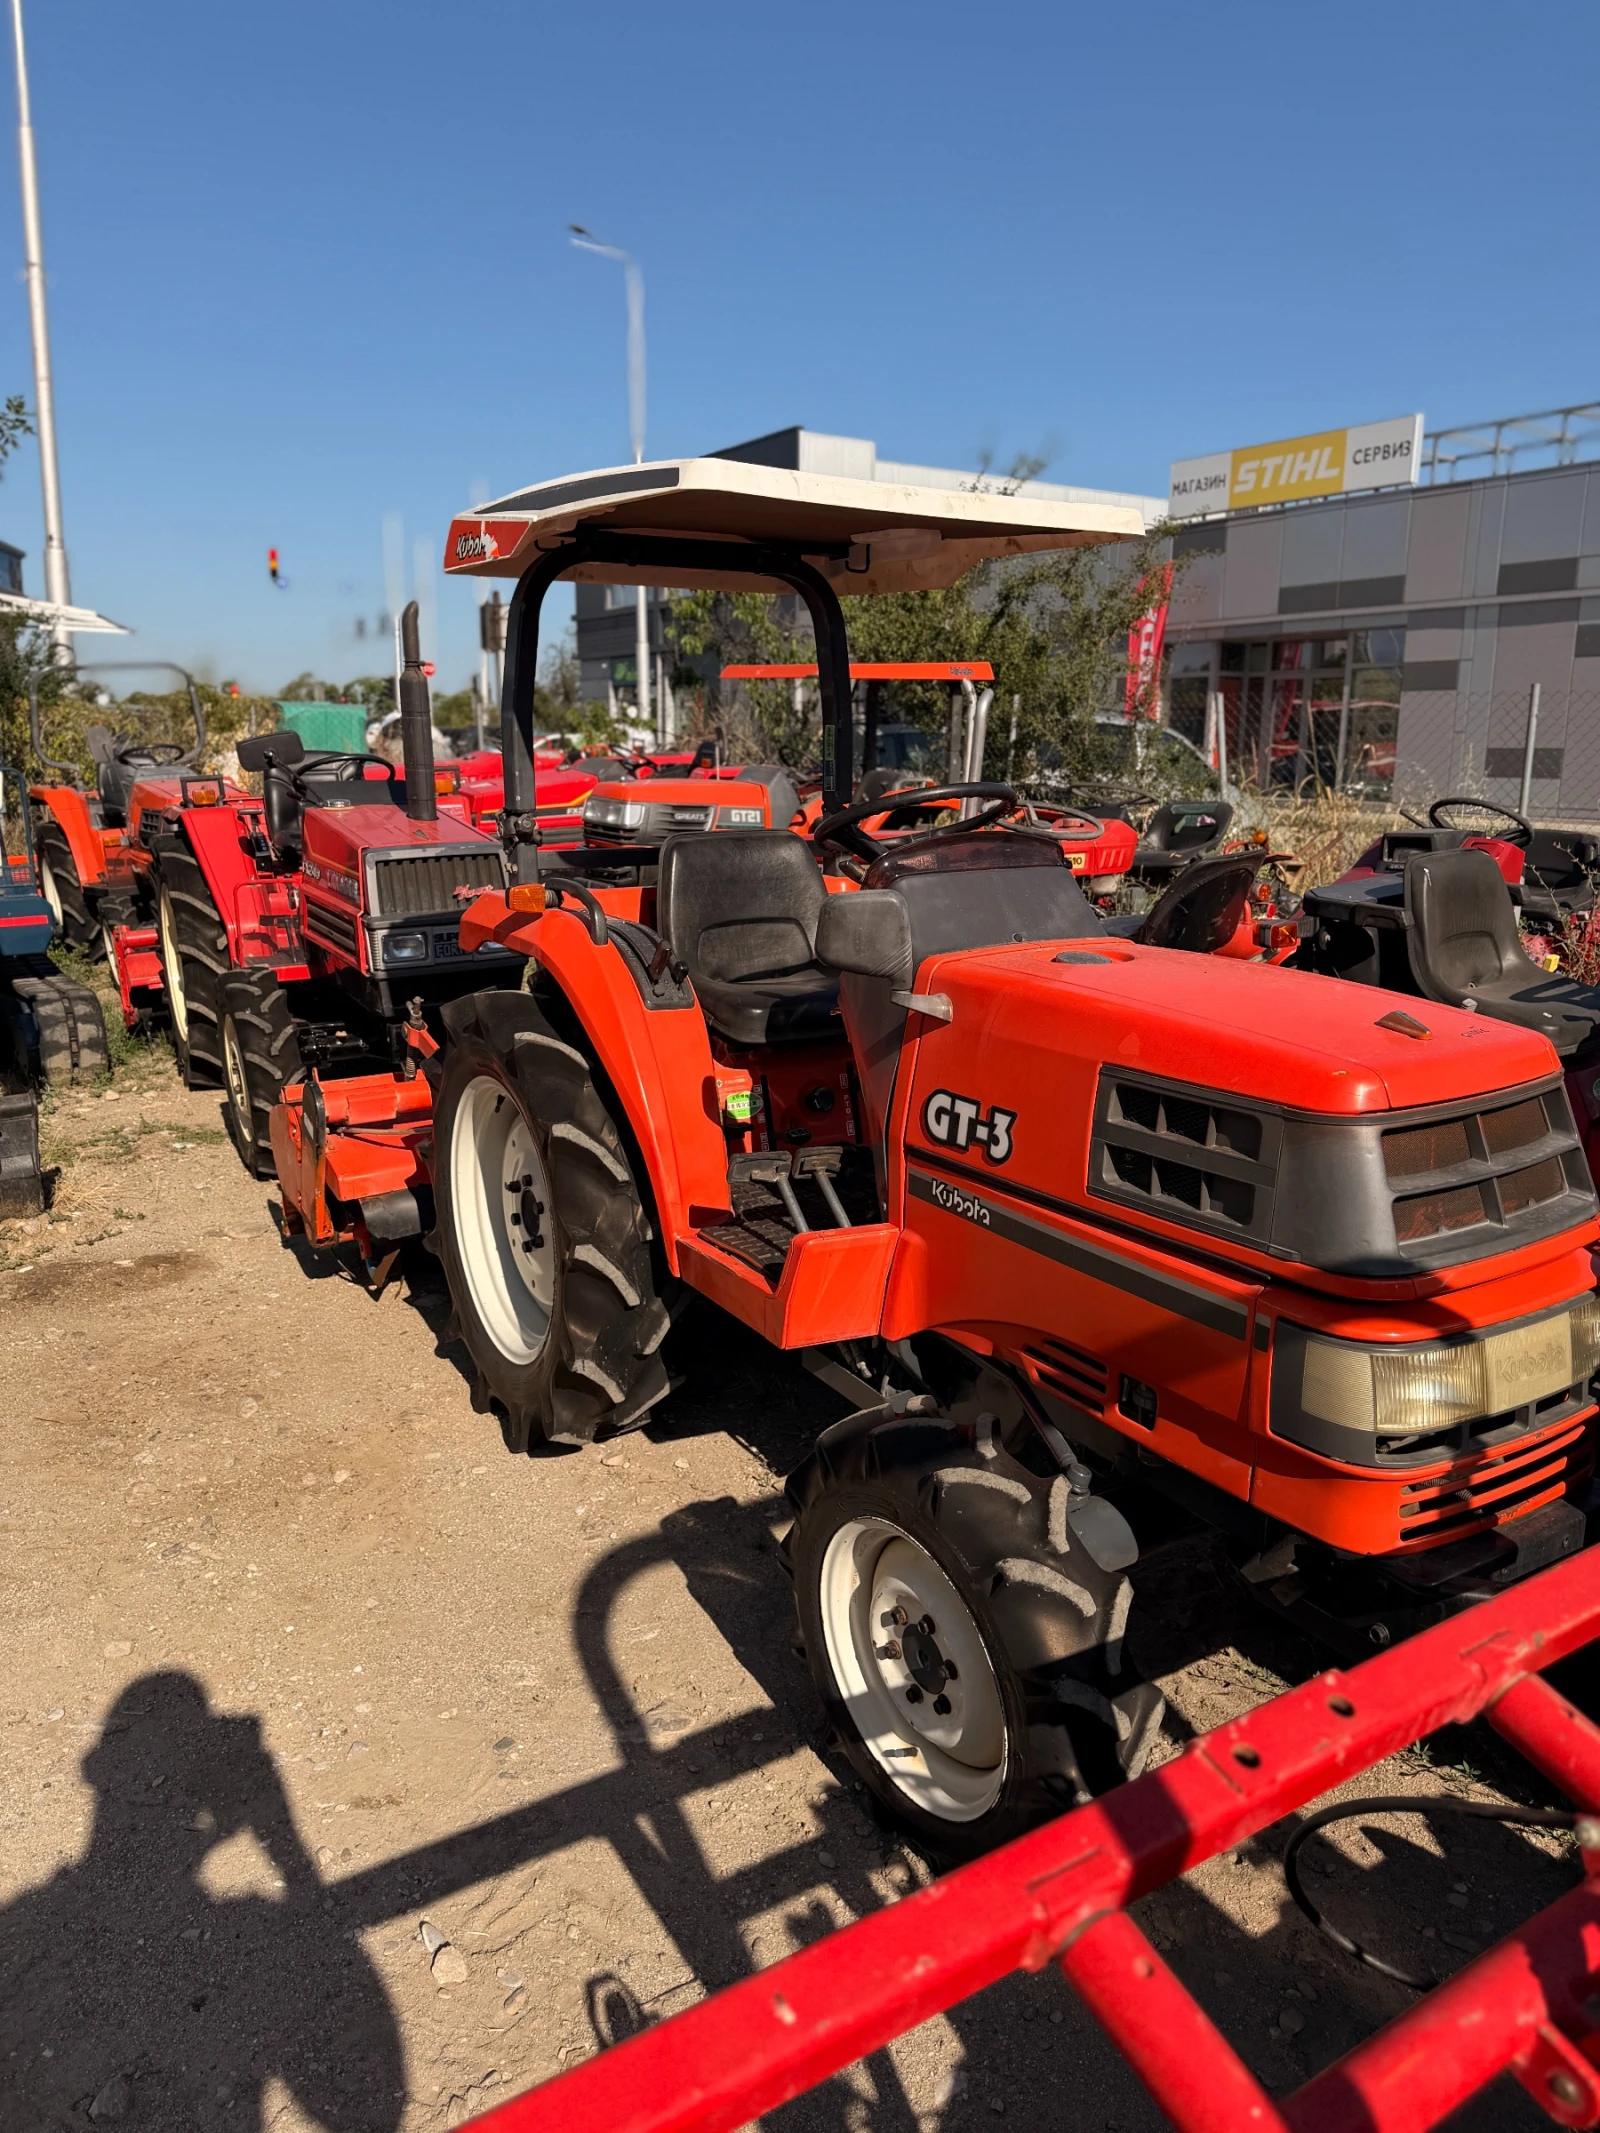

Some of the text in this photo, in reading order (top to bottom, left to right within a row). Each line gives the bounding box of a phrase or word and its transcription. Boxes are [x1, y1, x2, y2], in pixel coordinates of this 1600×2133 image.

[1352, 440, 1412, 466] СЕРВИЗ
[1232, 446, 1341, 494] STIHL
[1172, 473, 1227, 497] МАГАЗИН
[456, 532, 486, 560] Kubo
[674, 812, 706, 821] GREATS
[731, 809, 761, 823] GT21
[924, 1090, 1015, 1164] GT-3
[931, 1179, 991, 1226] Kubota
[1495, 1342, 1566, 1384] Kubota
